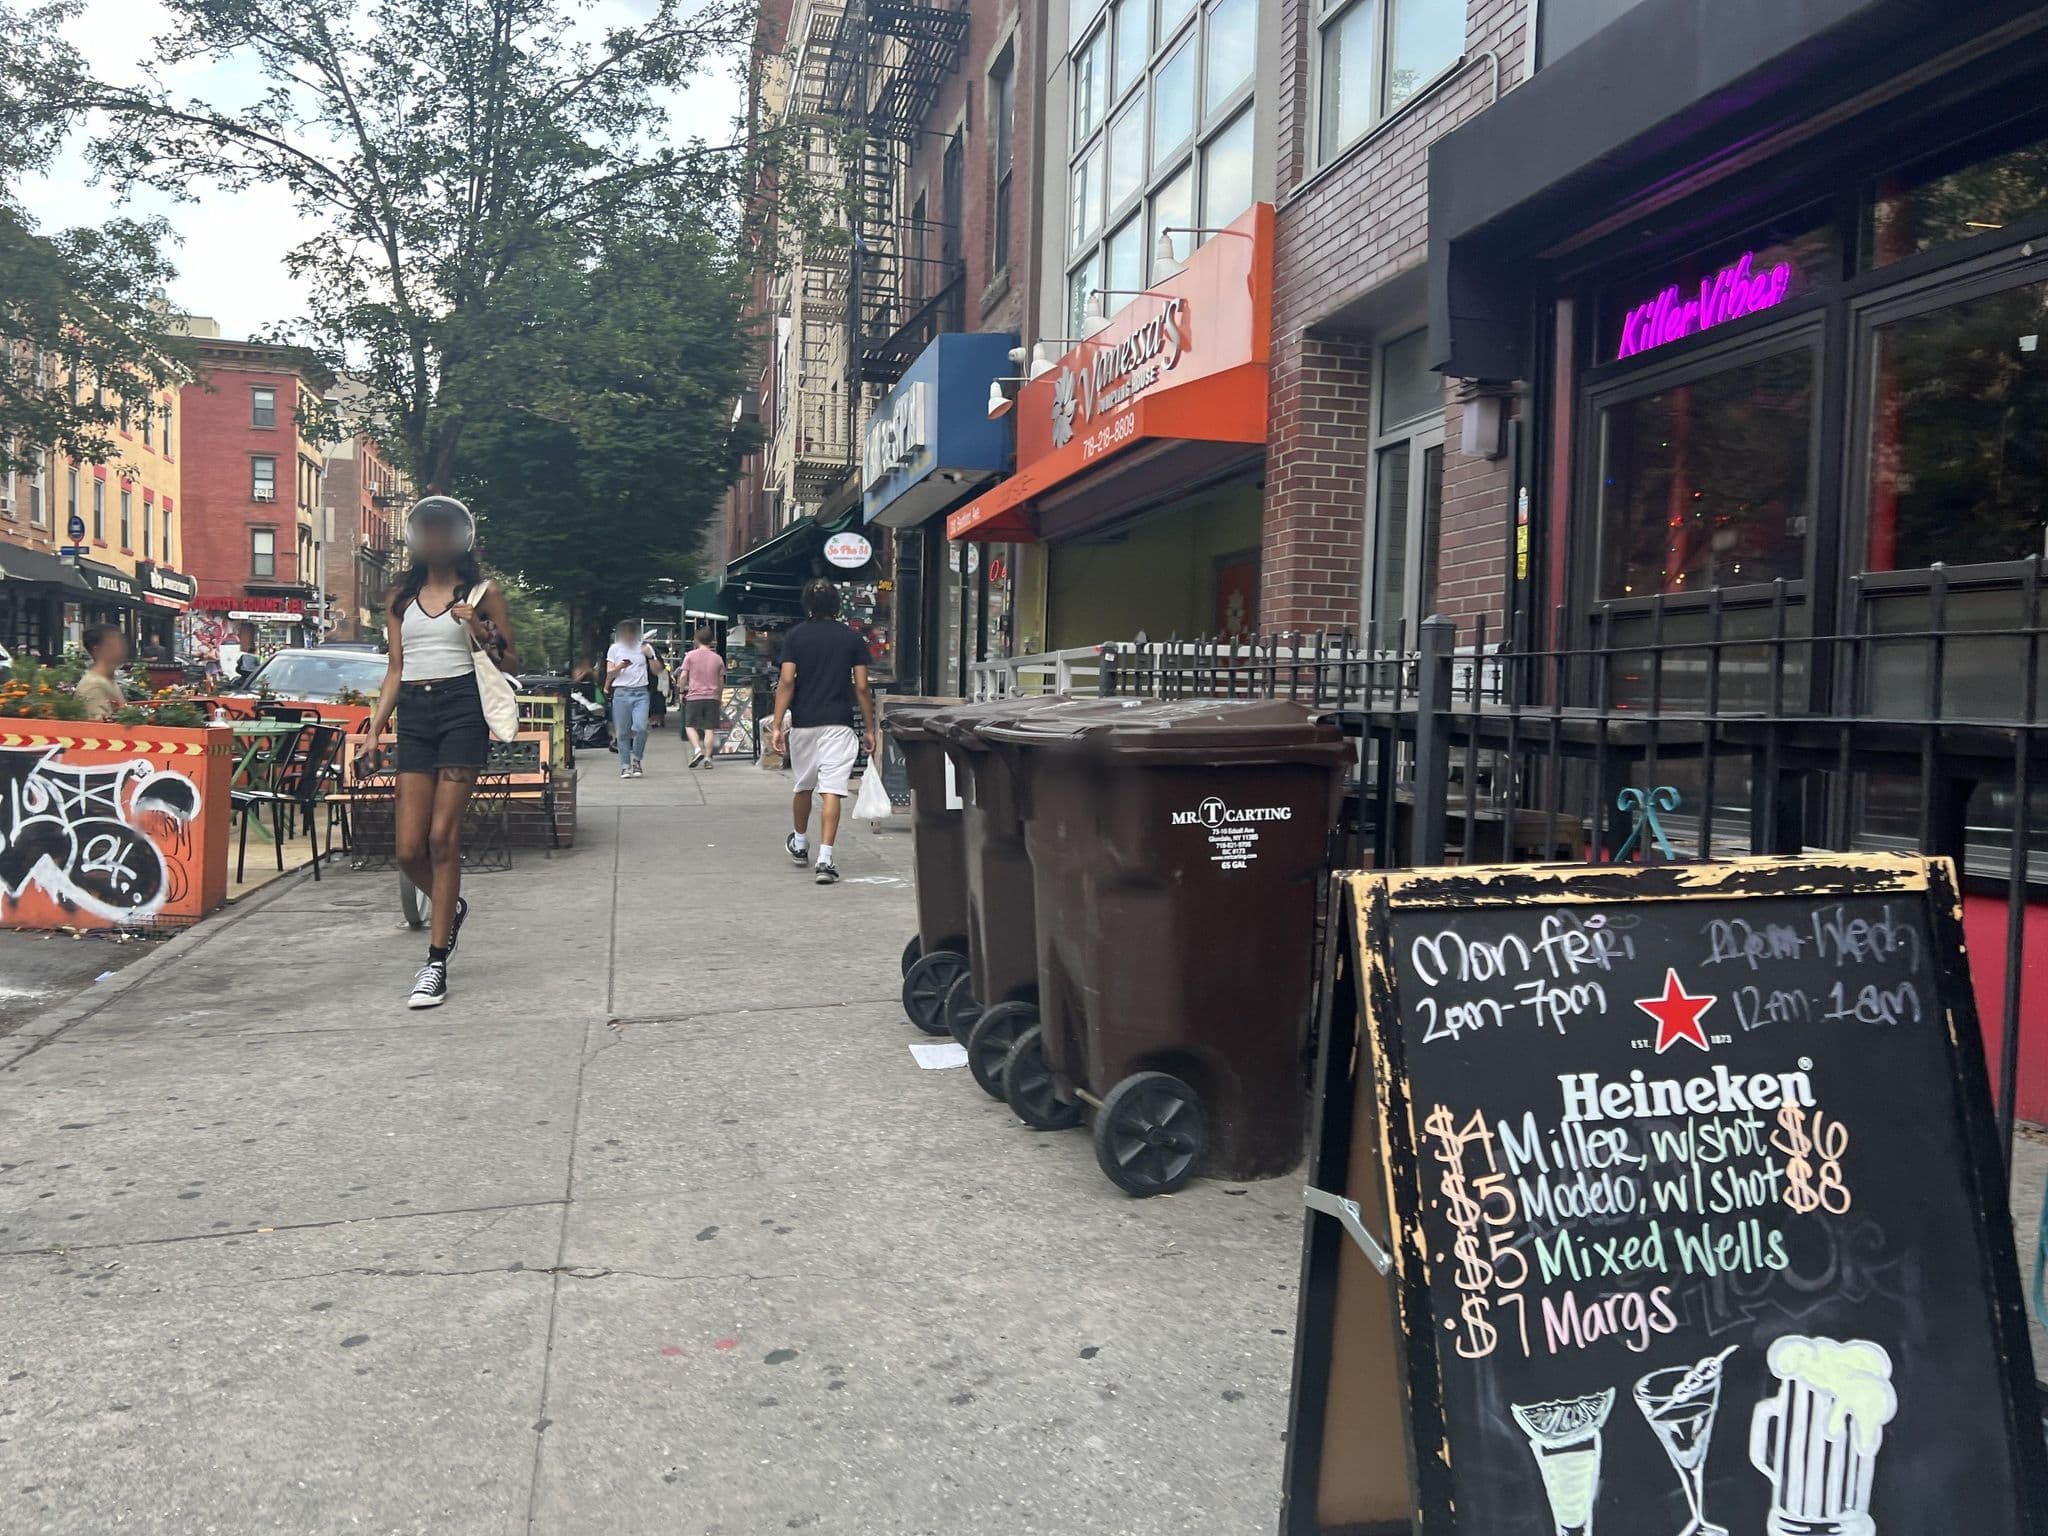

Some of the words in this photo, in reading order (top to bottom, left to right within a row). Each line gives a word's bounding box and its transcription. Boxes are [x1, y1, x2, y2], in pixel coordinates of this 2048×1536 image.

[1617, 284, 1699, 360] Killer
[1700, 250, 1791, 330] Vibes
[1131, 364, 1160, 396] HOUSE
[1083, 412, 1135, 461] 718-218-8809
[97, 575, 120, 592] ROYAL
[119, 581, 132, 595] SPA
[1203, 802, 1222, 823] T
[1225, 807, 1292, 822] CARTING
[1231, 861, 1247, 869] GAL
[1557, 1065, 1817, 1122] Heineken
[1453, 1228, 1529, 1293] $5
[1535, 1219, 1668, 1285] Mixed
[1674, 1218, 1790, 1277] Wells
[1455, 1293, 1531, 1359] $7
[1541, 1286, 1678, 1354] Margs
